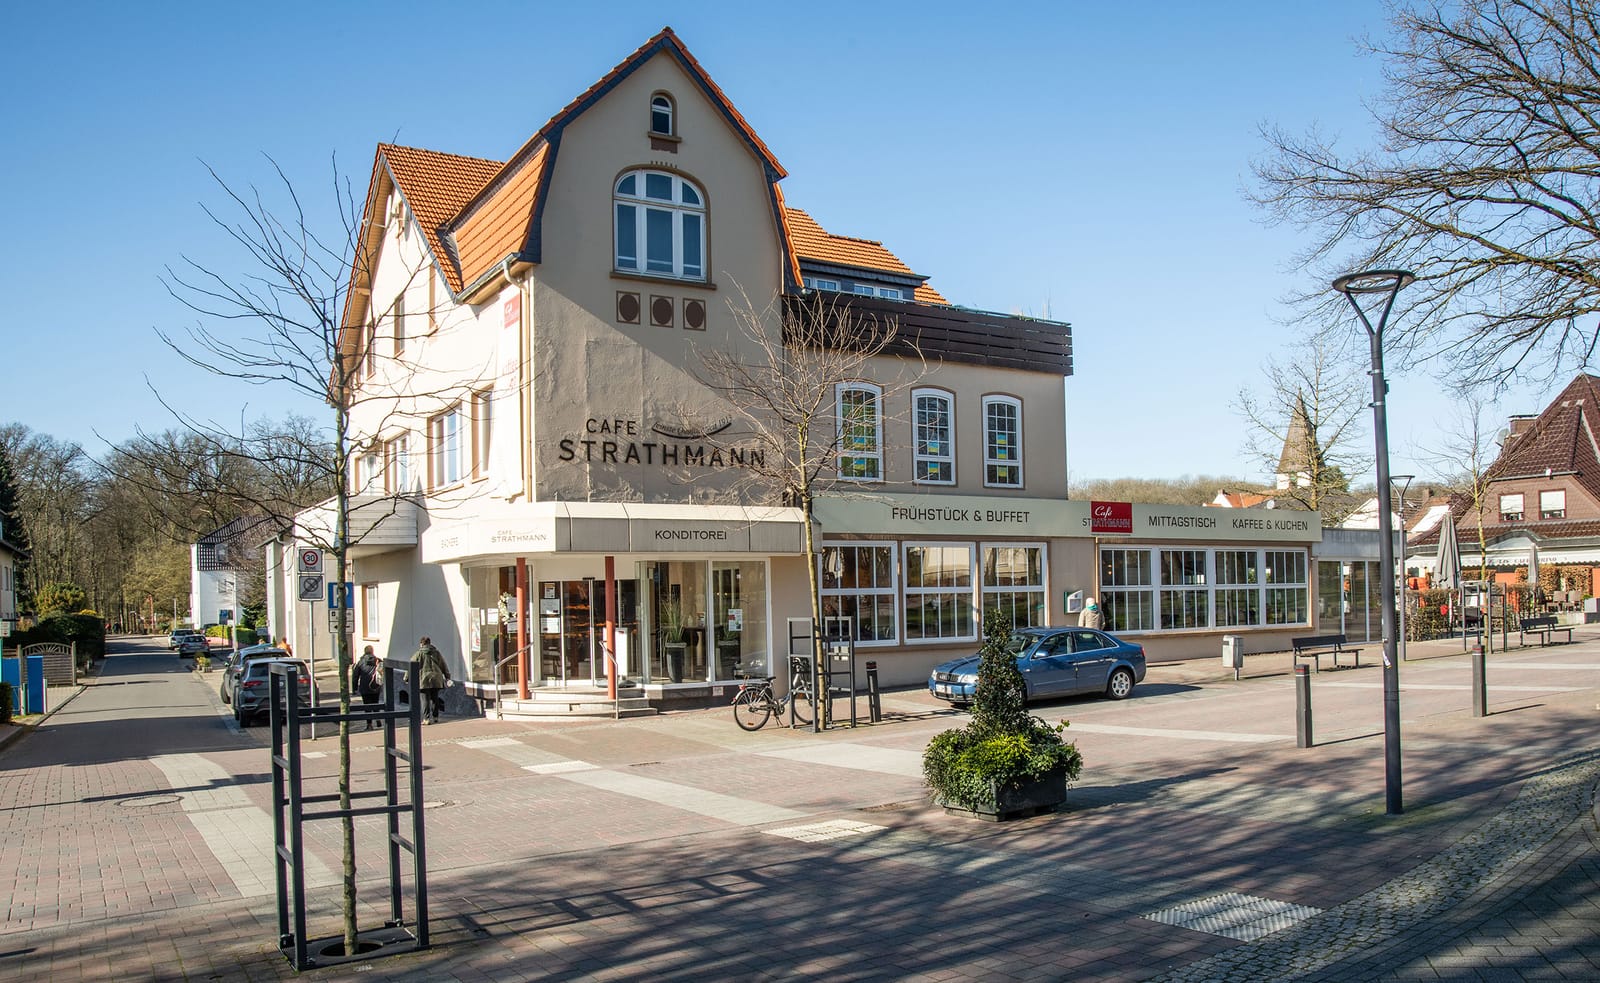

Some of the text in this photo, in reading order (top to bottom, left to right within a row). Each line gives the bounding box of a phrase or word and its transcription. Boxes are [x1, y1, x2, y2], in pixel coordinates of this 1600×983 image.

[586, 418, 637, 435] CAFE
[559, 439, 765, 468] STRATHMANN
[892, 506, 1030, 523] FRÜHSTÜCK & BUFFET
[1148, 515, 1217, 528] MITTAGSTISCH
[1232, 518, 1308, 531] KAFFEE & KUCHEN
[491, 534, 547, 543] STRATHMANN
[655, 530, 727, 540] KONDITOREI
